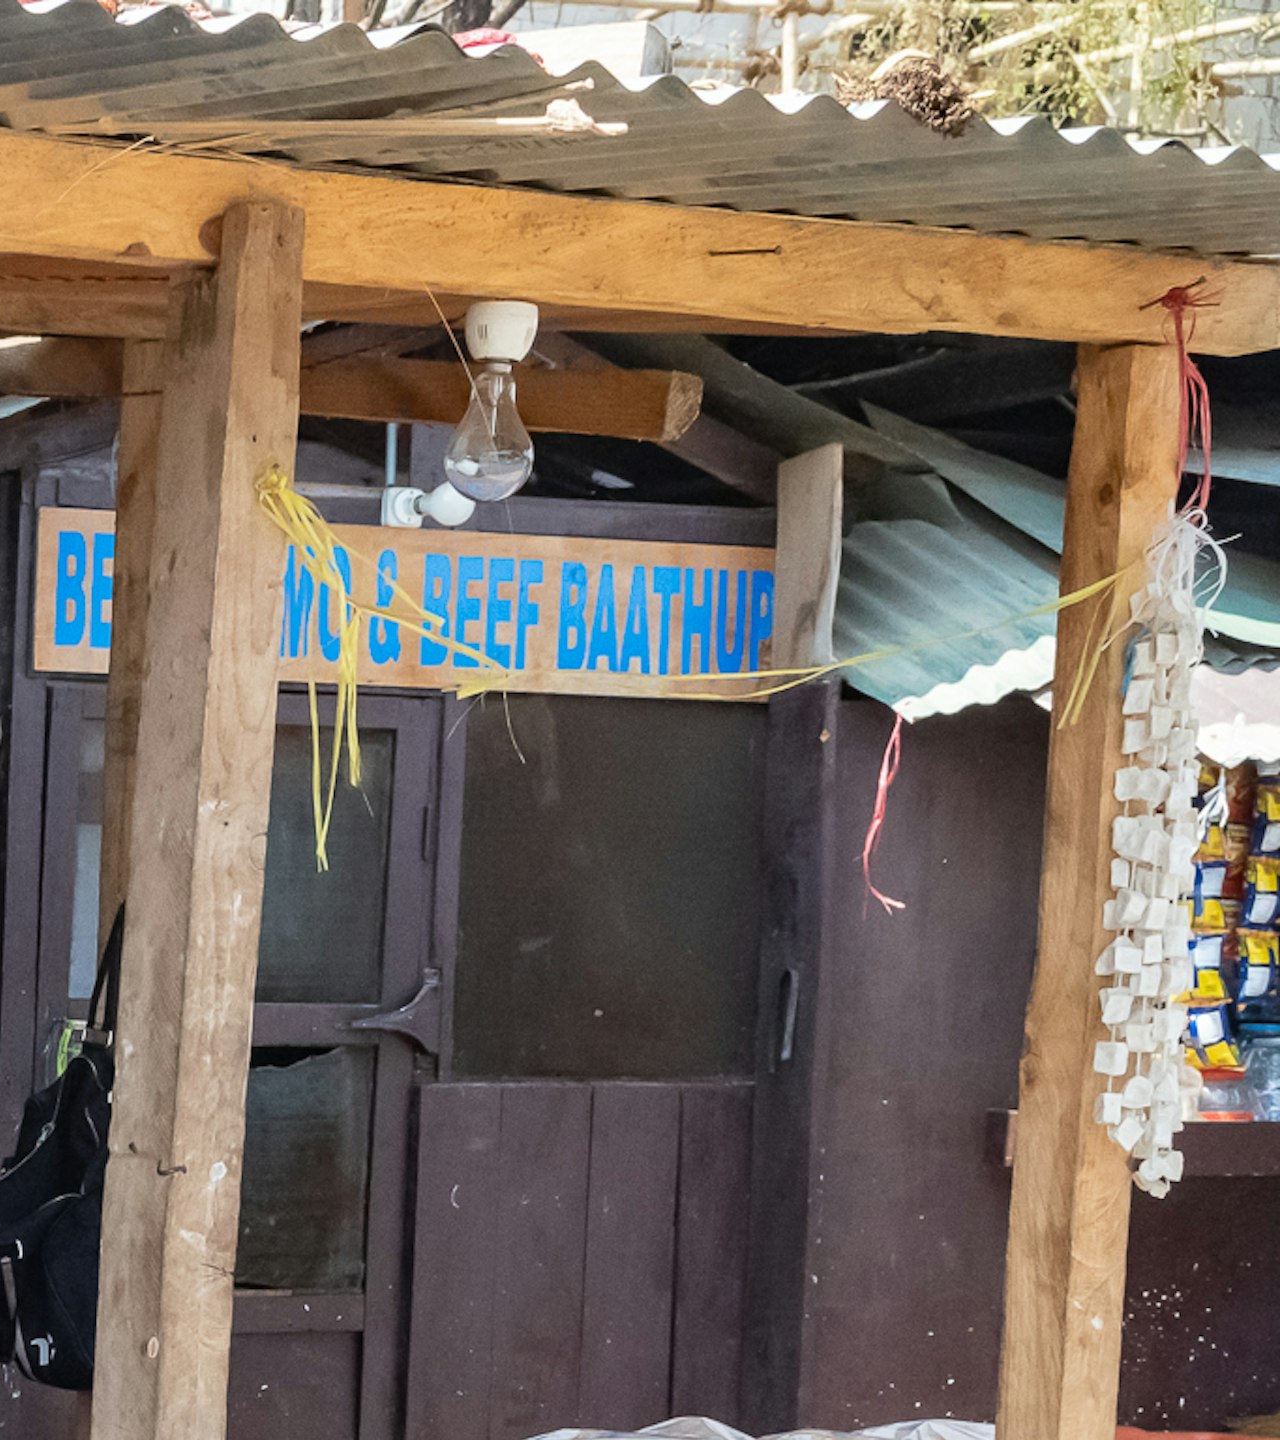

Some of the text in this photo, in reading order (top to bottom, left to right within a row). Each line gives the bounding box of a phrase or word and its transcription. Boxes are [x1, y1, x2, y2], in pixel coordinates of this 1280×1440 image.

[370, 547, 402, 666] &
[420, 553, 544, 671] BEEF
[556, 561, 775, 678] BAATHUP
